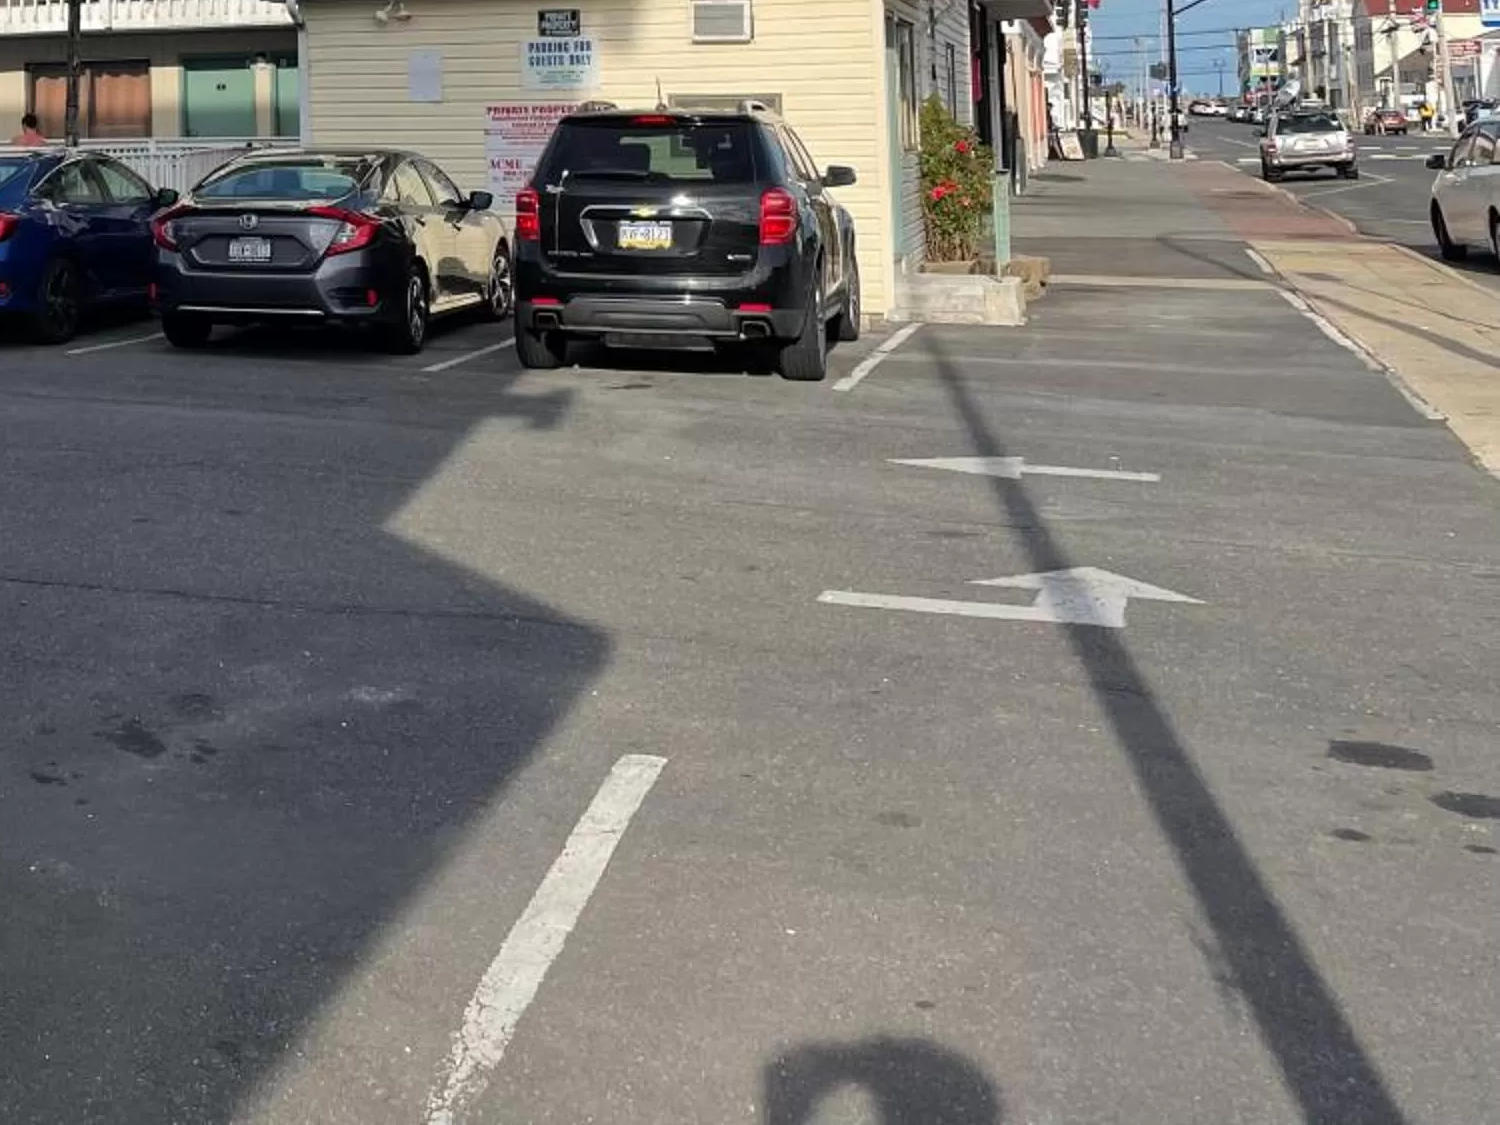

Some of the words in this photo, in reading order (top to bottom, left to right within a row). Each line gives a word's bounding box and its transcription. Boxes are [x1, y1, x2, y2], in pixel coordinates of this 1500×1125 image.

[528, 43, 570, 53] PARKING
[574, 41, 592, 52] FOR
[569, 54, 591, 66] ONLY
